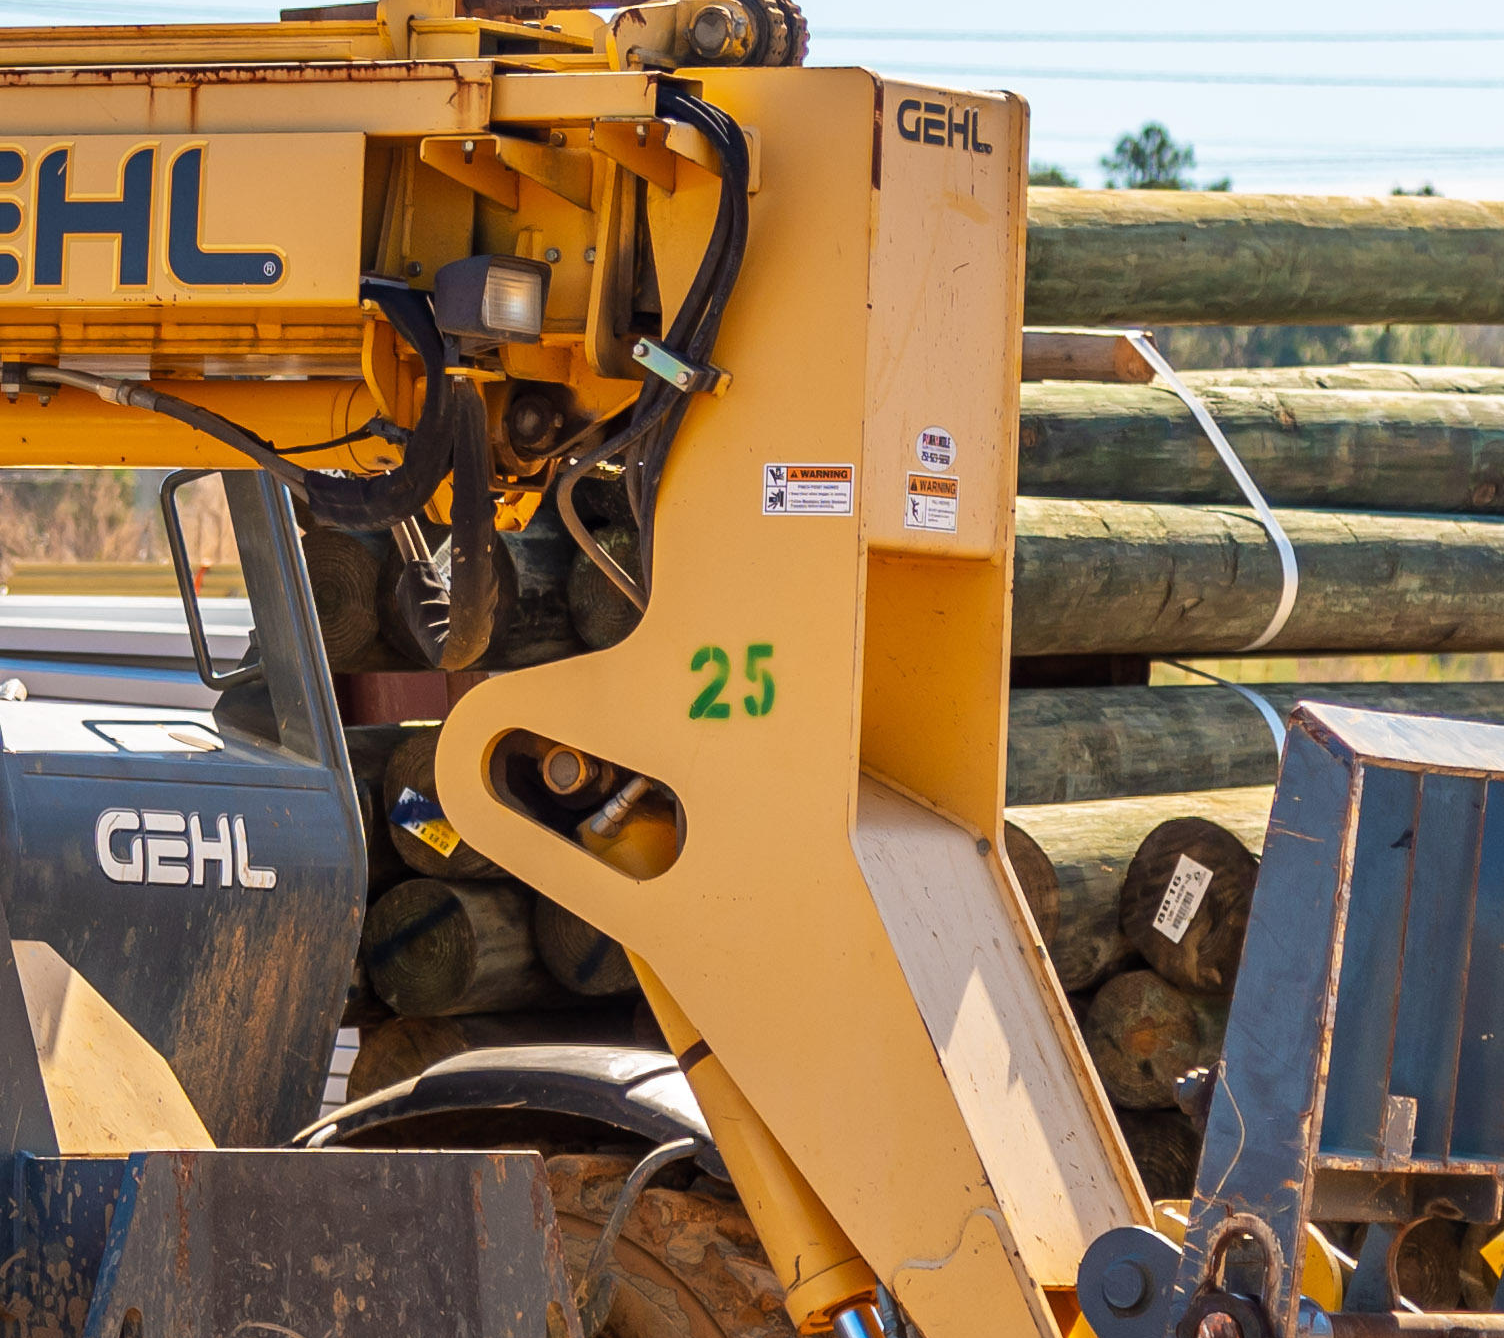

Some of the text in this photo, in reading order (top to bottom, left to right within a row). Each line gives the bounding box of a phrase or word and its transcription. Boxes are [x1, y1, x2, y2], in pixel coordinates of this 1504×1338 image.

[896, 98, 993, 155] GEHL
[800, 469, 849, 479] WARNING
[919, 479, 957, 495] WARNING
[688, 643, 776, 721] 25
[95, 807, 278, 891] GEHL
